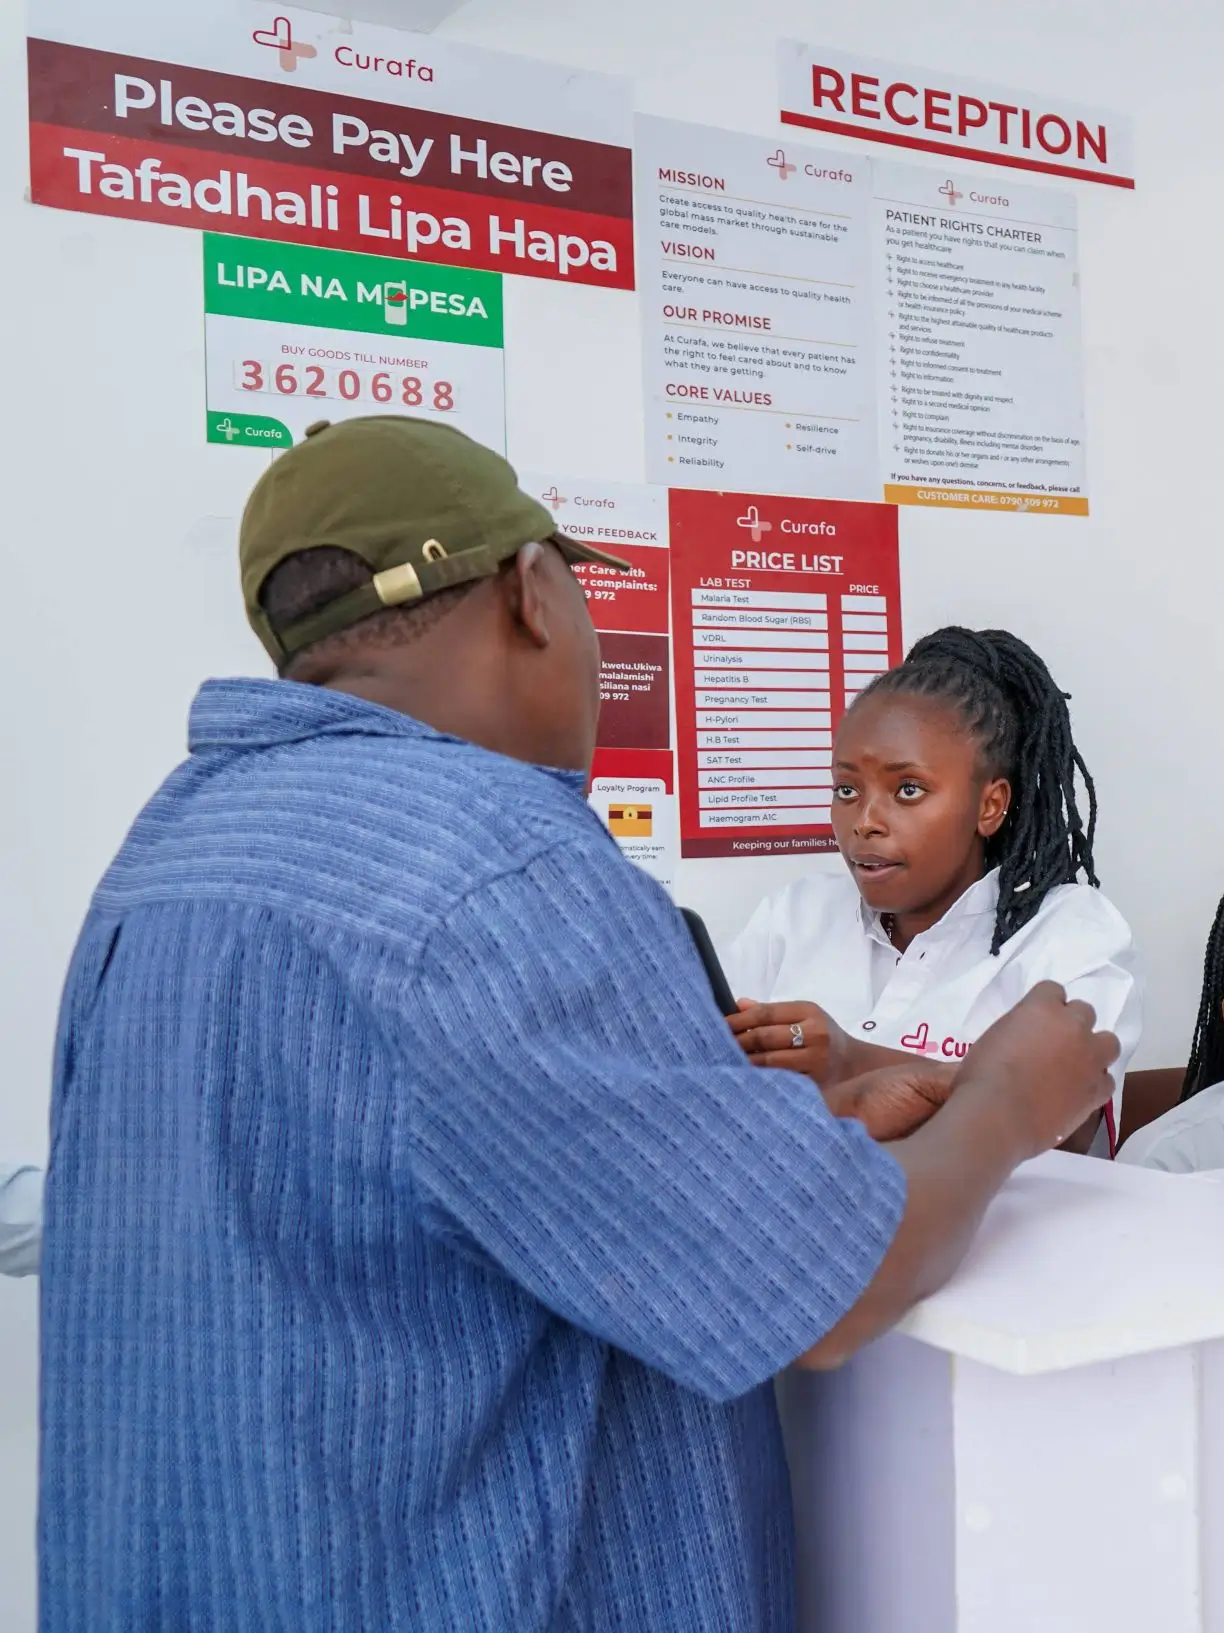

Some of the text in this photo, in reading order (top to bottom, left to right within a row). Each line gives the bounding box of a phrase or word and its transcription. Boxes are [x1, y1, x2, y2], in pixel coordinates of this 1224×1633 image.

[335, 46, 433, 82] Curafa
[812, 64, 1107, 164] RECEPTION
[115, 74, 573, 192] Please Pay Here
[659, 168, 724, 190] MISSION
[804, 164, 852, 182] Curafa
[969, 192, 1009, 206] Curafa
[64, 147, 618, 274] Tafadhali Lipa Hapa
[660, 195, 689, 206] Create
[692, 202, 722, 211] access
[736, 209, 766, 220] quality
[769, 214, 797, 223] health
[660, 220, 680, 229] care
[660, 208, 838, 242] global mass market through sustainable
[886, 210, 1041, 242] PATIENT RIGHTS CHARTER
[886, 225, 895, 233] As
[902, 229, 928, 238] patient
[944, 234, 961, 243] have
[962, 238, 982, 246] rights
[661, 241, 714, 260] VISION
[915, 241, 952, 253] healthcare
[218, 262, 292, 293] LIPA
[301, 274, 348, 301] NA
[662, 270, 704, 283] Everyone
[726, 280, 747, 289] have
[750, 284, 778, 294] access
[792, 291, 821, 301] quality
[824, 294, 850, 303] health
[663, 305, 771, 330] OUR PROMISE
[281, 345, 428, 368] BUY GOODS TILL NUMBER
[728, 342, 759, 352] believe
[762, 346, 780, 355] that
[782, 350, 805, 359] every
[808, 353, 838, 362] patient
[664, 347, 680, 355] the
[682, 349, 704, 358] right
[719, 353, 735, 361] feel
[766, 360, 791, 368] about
[824, 365, 847, 374] know
[665, 360, 688, 368] what
[691, 362, 710, 372] they
[666, 384, 772, 405] CORE VALUES
[678, 413, 718, 425] Empathy
[245, 427, 282, 438] Curafa
[796, 423, 839, 434] Resilience
[678, 435, 718, 446] Integrity
[796, 445, 836, 455] Self-drive
[680, 457, 724, 468] Reliability
[574, 496, 615, 508] Curafa
[917, 490, 969, 502] CUSTOMER
[1043, 499, 1058, 508] 972
[562, 525, 657, 540] YOUR FEEDBACK
[780, 520, 836, 535] Curafa
[732, 550, 844, 572] PRICE LIST
[589, 564, 618, 575] Care
[590, 580, 657, 591] complaints:
[700, 577, 751, 588] LAB TEST
[849, 584, 879, 594] PRICE
[594, 591, 616, 600] 972
[764, 616, 788, 624] Sugar
[790, 616, 811, 625] (RBS)
[704, 655, 743, 664] Urinalysis
[704, 676, 741, 684] Hepatitis
[632, 683, 651, 692] nasi
[705, 696, 749, 704] Pregnancy
[706, 716, 738, 724] H-Pylori
[627, 785, 660, 793] Program
[733, 840, 772, 850] Keeping
[792, 838, 827, 847] families
